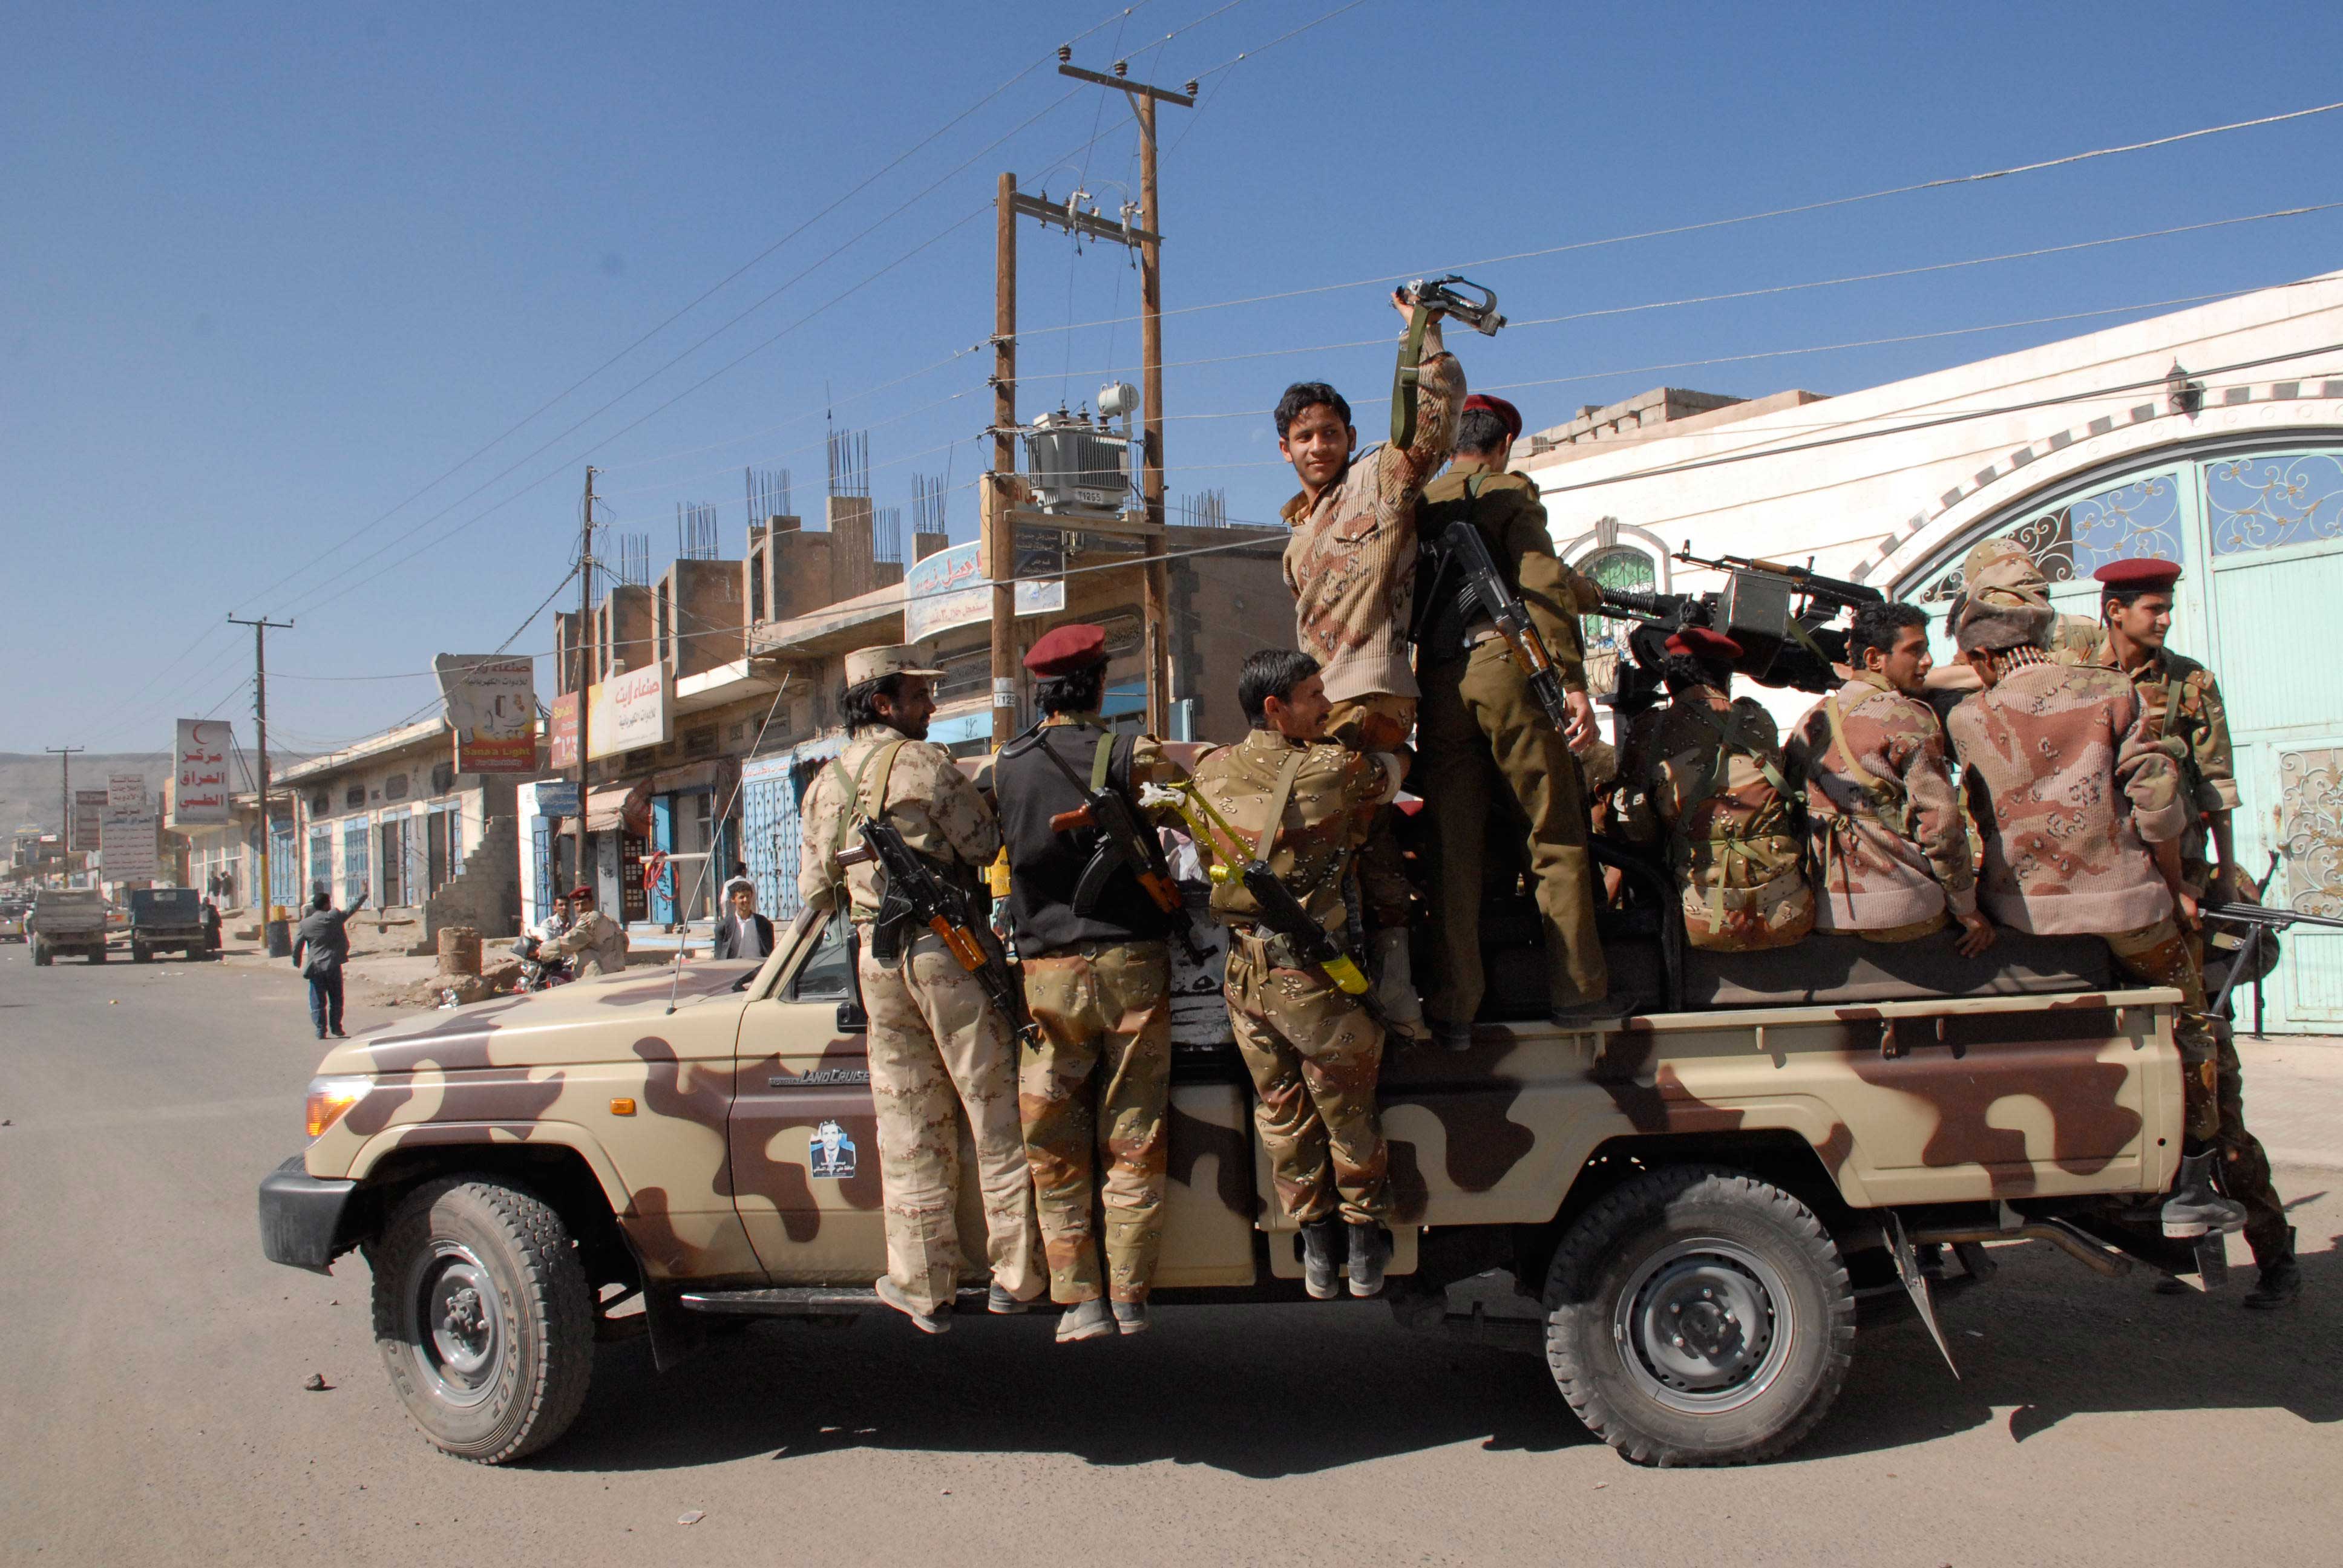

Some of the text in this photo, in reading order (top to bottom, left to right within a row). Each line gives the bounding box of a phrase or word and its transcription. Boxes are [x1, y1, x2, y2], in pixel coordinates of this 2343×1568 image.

[635, 678, 660, 699] صنعاء
[182, 748, 223, 765] مركز
[503, 747, 531, 757] Light
[180, 770, 224, 786] العراق
[179, 794, 224, 812] الطبي
[830, 1068, 871, 1083] CRUISE
